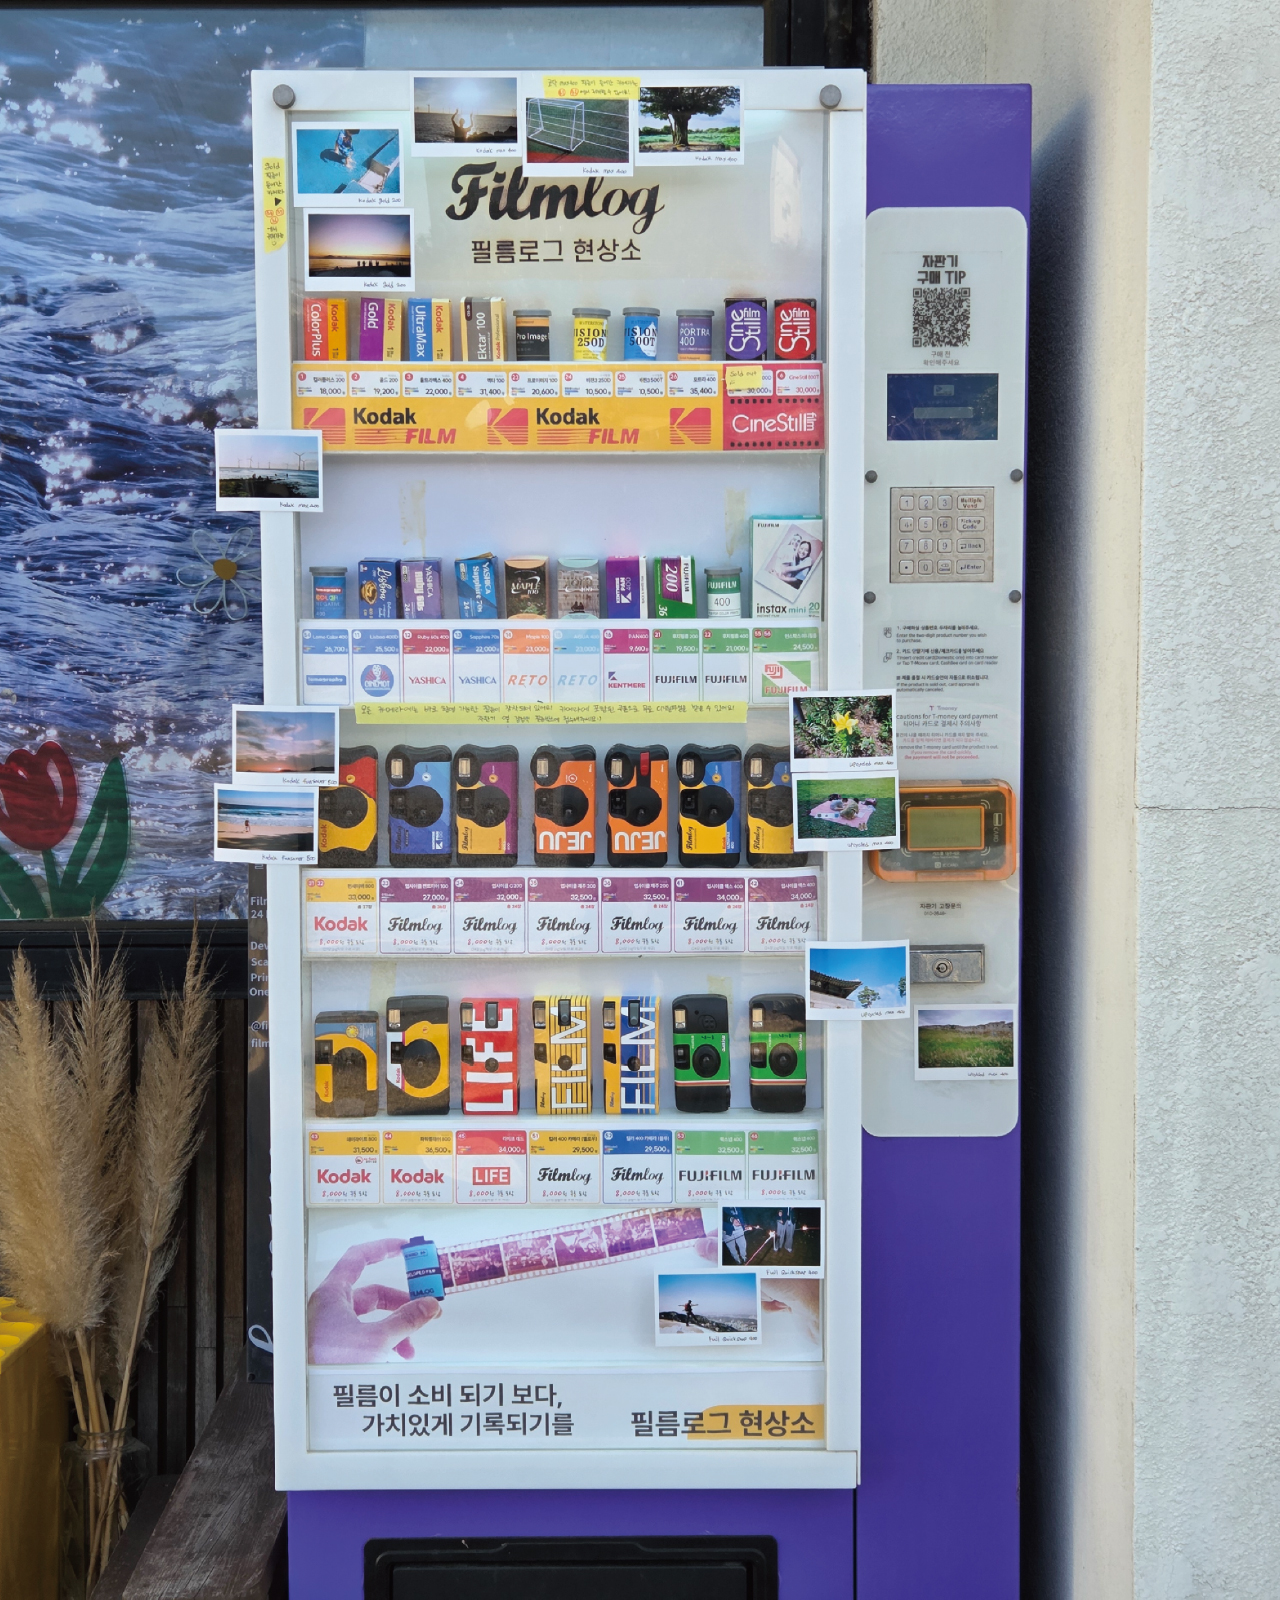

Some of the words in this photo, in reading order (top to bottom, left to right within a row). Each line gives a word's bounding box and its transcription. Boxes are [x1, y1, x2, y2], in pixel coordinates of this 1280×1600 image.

[444, 162, 665, 234] Filmlog
[471, 239, 564, 262] 필름로그
[573, 239, 642, 262] 현상소
[922, 255, 958, 268] 자판기
[916, 270, 941, 284] 구매
[944, 270, 966, 284] TIP
[330, 303, 339, 333] Kodak
[366, 302, 378, 330] Gold
[387, 303, 396, 331] Kodak
[435, 305, 444, 334] Kodak
[476, 312, 487, 326] 100
[310, 303, 322, 357] ColorPlus
[415, 304, 427, 358] UltraMax
[527, 333, 548, 342] Image
[680, 327, 710, 336] PORTRA
[477, 327, 487, 360] Ektar
[577, 337, 605, 348] 250D
[629, 337, 656, 347] 500T
[680, 337, 695, 346] 400
[320, 388, 341, 396] 18,000
[374, 388, 394, 396] 19,200
[425, 388, 448, 396] 22,000
[480, 388, 501, 396] 31,400
[532, 388, 554, 396] 20,600
[586, 388, 607, 396] 10,500
[639, 388, 659, 396] 10,500
[690, 387, 712, 396] 35,400
[795, 386, 817, 394] 30,000
[353, 407, 417, 425] Kodak
[536, 407, 601, 425] Kodak
[732, 413, 807, 433] CineStill
[405, 428, 457, 445] FILM
[588, 428, 640, 445] FILM
[424, 565, 434, 598] YASHICA
[481, 561, 492, 595] YASHICA
[665, 563, 678, 593] 200
[707, 580, 738, 590] FUJIFILM
[713, 597, 731, 607] 400
[756, 602, 787, 614] instax
[788, 606, 807, 614] mini
[808, 602, 821, 611] 20
[658, 605, 668, 617] 36
[408, 676, 447, 685] YASHICA
[458, 676, 497, 685] YASHICA
[507, 674, 548, 686] RETO
[557, 674, 597, 686] RETO
[655, 675, 698, 684] FUJIFILM
[705, 675, 748, 684] FUJIFILM
[320, 823, 328, 849] Kodak
[539, 830, 592, 851] JEJU
[614, 830, 666, 851] JEJU
[422, 894, 445, 902] 27,000
[250, 910, 264, 919] 24
[314, 916, 368, 931] Kodak
[387, 916, 443, 935] Filmlog
[462, 916, 518, 935] Filmlog
[536, 916, 591, 935] Filmlog
[610, 916, 664, 934] Filmlog
[682, 916, 738, 934] Filmlog
[756, 916, 811, 933] Filmlog
[466, 1008, 513, 1112] LIFE
[620, 1006, 656, 1109] FILM
[352, 1146, 374, 1154] 31,500
[425, 1146, 447, 1154] 36,500
[644, 1145, 667, 1153] 29,500
[317, 1168, 372, 1184] Kodak
[391, 1168, 445, 1184] Kodak
[475, 1168, 509, 1183] LIFE
[537, 1167, 592, 1185] Filmlog
[610, 1167, 664, 1185] Filmlog
[678, 1170, 742, 1181] FUJIFILM
[752, 1169, 816, 1181] FUJIFILM
[333, 1384, 401, 1407] 필름이
[408, 1384, 453, 1407] 소비
[460, 1384, 505, 1407] 되기
[511, 1384, 563, 1409] 보다,
[362, 1412, 453, 1436] 가치있게
[460, 1412, 575, 1436] 기록되기를
[630, 1411, 732, 1436] 필름로그
[739, 1410, 815, 1436] 현상소
